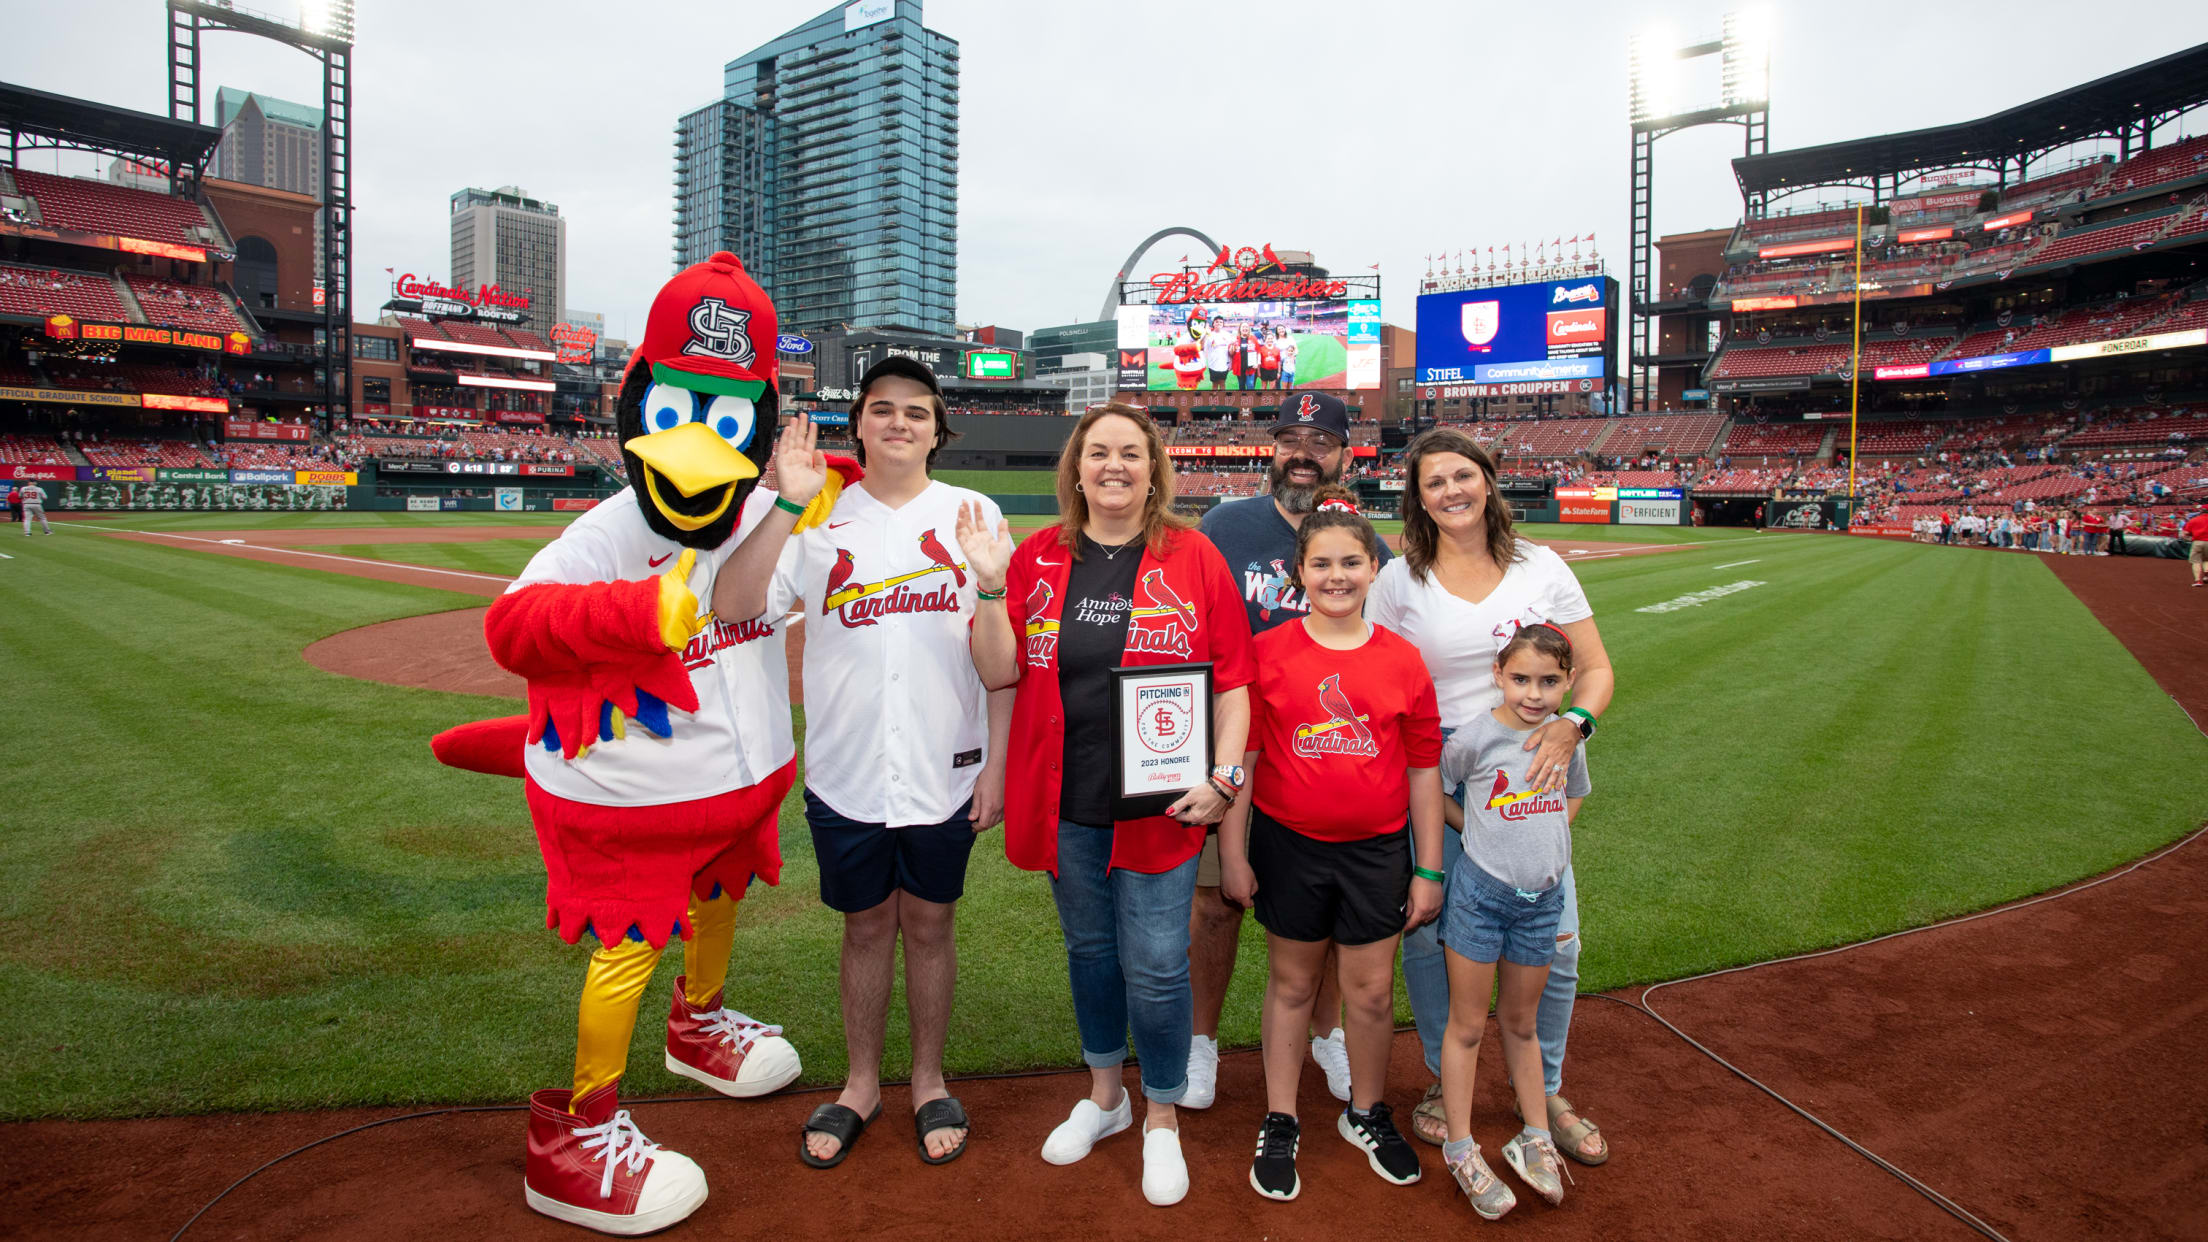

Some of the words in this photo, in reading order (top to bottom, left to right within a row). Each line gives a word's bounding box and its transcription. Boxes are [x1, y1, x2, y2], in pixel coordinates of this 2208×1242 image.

[1920, 171, 1975, 183] BUDWEISER
[1926, 193, 1981, 206] BUDWEISER
[1437, 277, 1490, 290] WORLD
[1493, 265, 1585, 283] CHAMPIONS
[397, 273, 470, 300] Cardinals
[470, 284, 529, 309] Nation
[1150, 272, 1347, 304] Budweiser
[422, 301, 464, 314] HOFFMANN
[477, 309, 519, 321] ROOFTOP
[1552, 320, 1598, 336] Cardinals
[82, 324, 122, 339] BIG
[124, 326, 170, 343] MAC
[172, 331, 222, 350] LAND
[550, 322, 599, 348] Bally
[779, 336, 805, 351] Ford
[2101, 339, 2149, 353] #ONEROAR
[888, 348, 919, 361] FROM
[920, 351, 941, 363] THE
[1427, 367, 1464, 381] STIFEL
[1444, 385, 1488, 398] BROWN
[1490, 387, 1498, 395] &
[1501, 381, 1570, 395] CROUPPEN
[38, 391, 86, 402] GRADUATE
[89, 393, 124, 404] SCHOOL
[831, 414, 848, 422] CREDI
[1215, 446, 1253, 457] BUSCH
[172, 472, 203, 480] Central
[204, 472, 228, 480] Bank
[537, 466, 565, 474] PURINA
[246, 472, 289, 482] Ballpark
[309, 473, 345, 481] DOBBS
[1621, 505, 1676, 518] PERFICIENT
[1248, 561, 1261, 571] the
[838, 583, 960, 629] Cardinals
[1074, 597, 1133, 611] Annie's
[1075, 609, 1120, 626] Hope
[1140, 687, 1182, 700] PITCHING
[1183, 687, 1190, 696] IN
[1292, 723, 1380, 759] Cardinals
[1141, 758, 1159, 767] 2023
[1160, 755, 1190, 765] HONOREE
